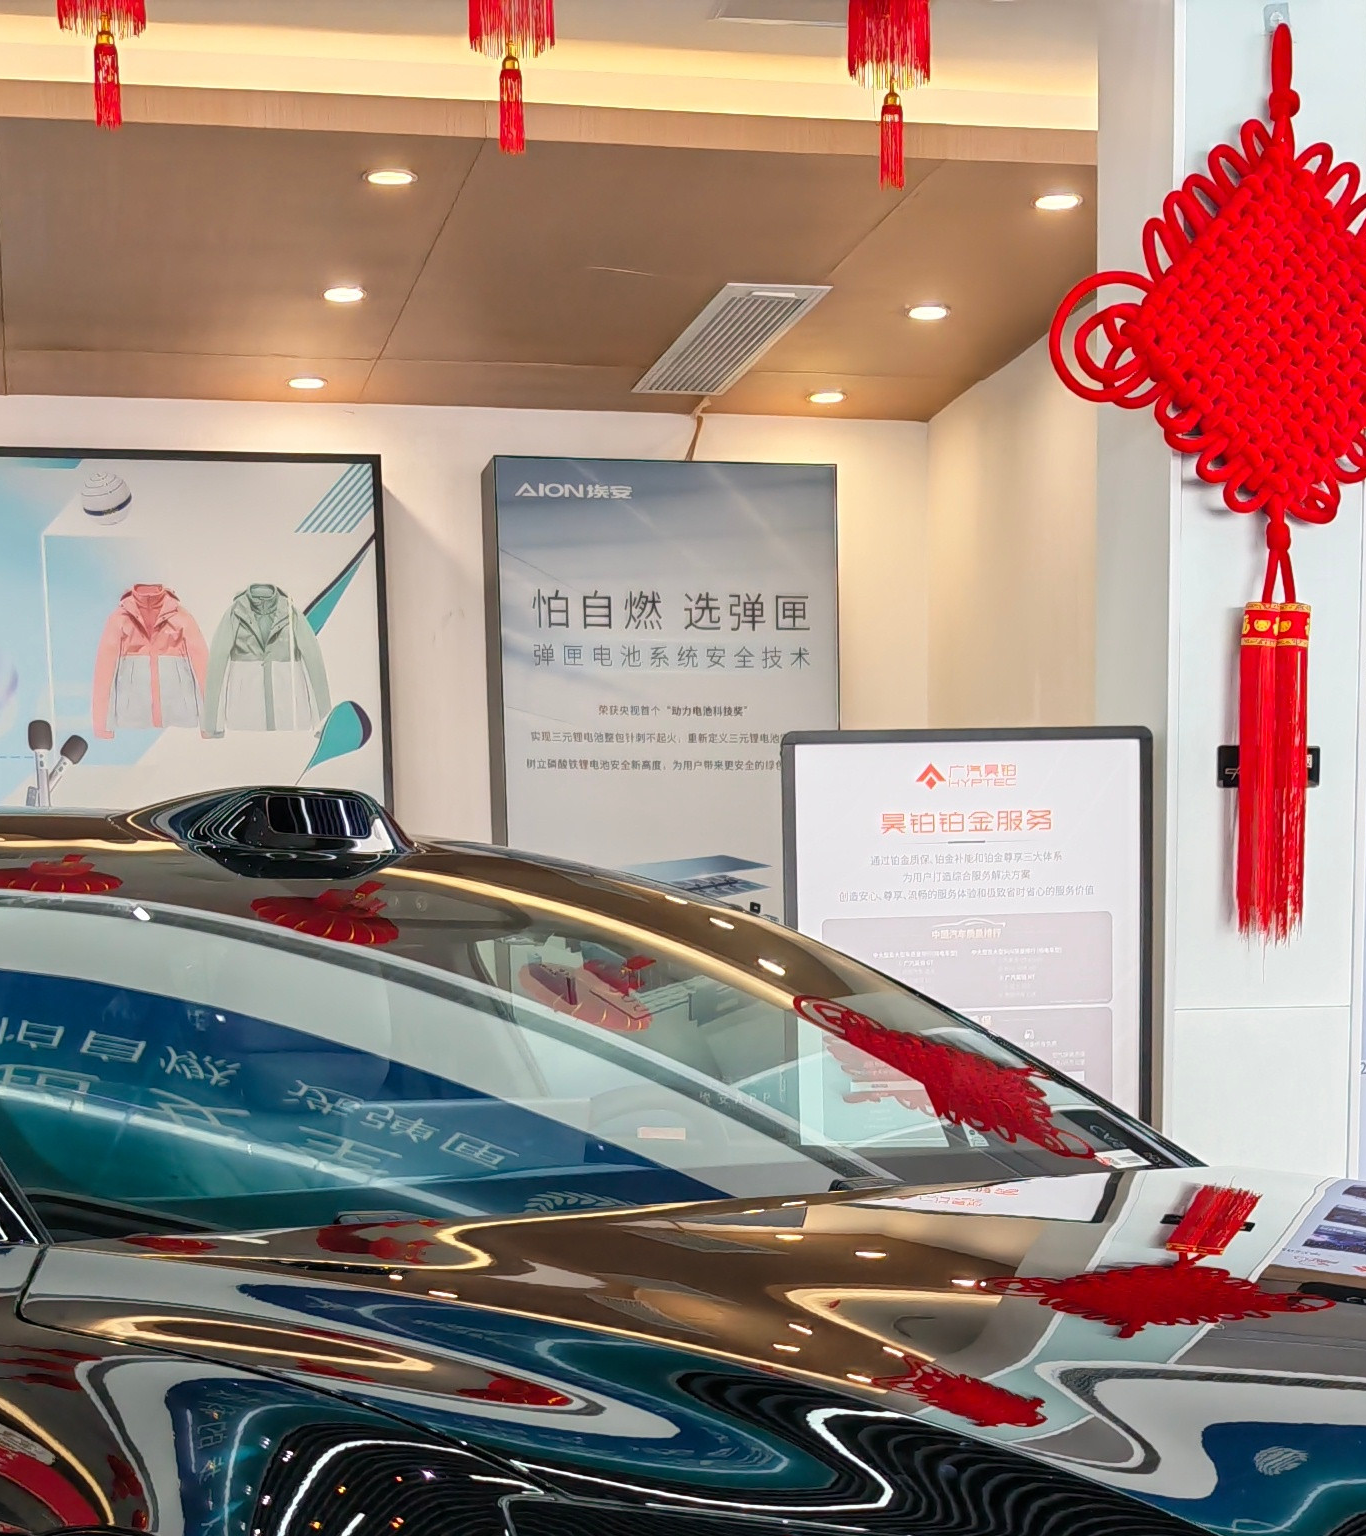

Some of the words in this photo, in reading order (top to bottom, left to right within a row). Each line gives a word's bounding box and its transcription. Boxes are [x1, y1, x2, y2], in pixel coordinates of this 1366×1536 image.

[531, 588, 663, 631] 怕自燃
[683, 591, 811, 632] 选弹匣
[532, 642, 811, 670] 弹匣电池系统安全技术
[530, 731, 785, 744] 实现三元锂电池整包针刺不起火，重新定义三元锂电池
[948, 763, 1017, 777] 广汽昊铂
[948, 778, 1017, 788] HYPTEC
[880, 809, 1052, 835] 昊铂铂金服务
